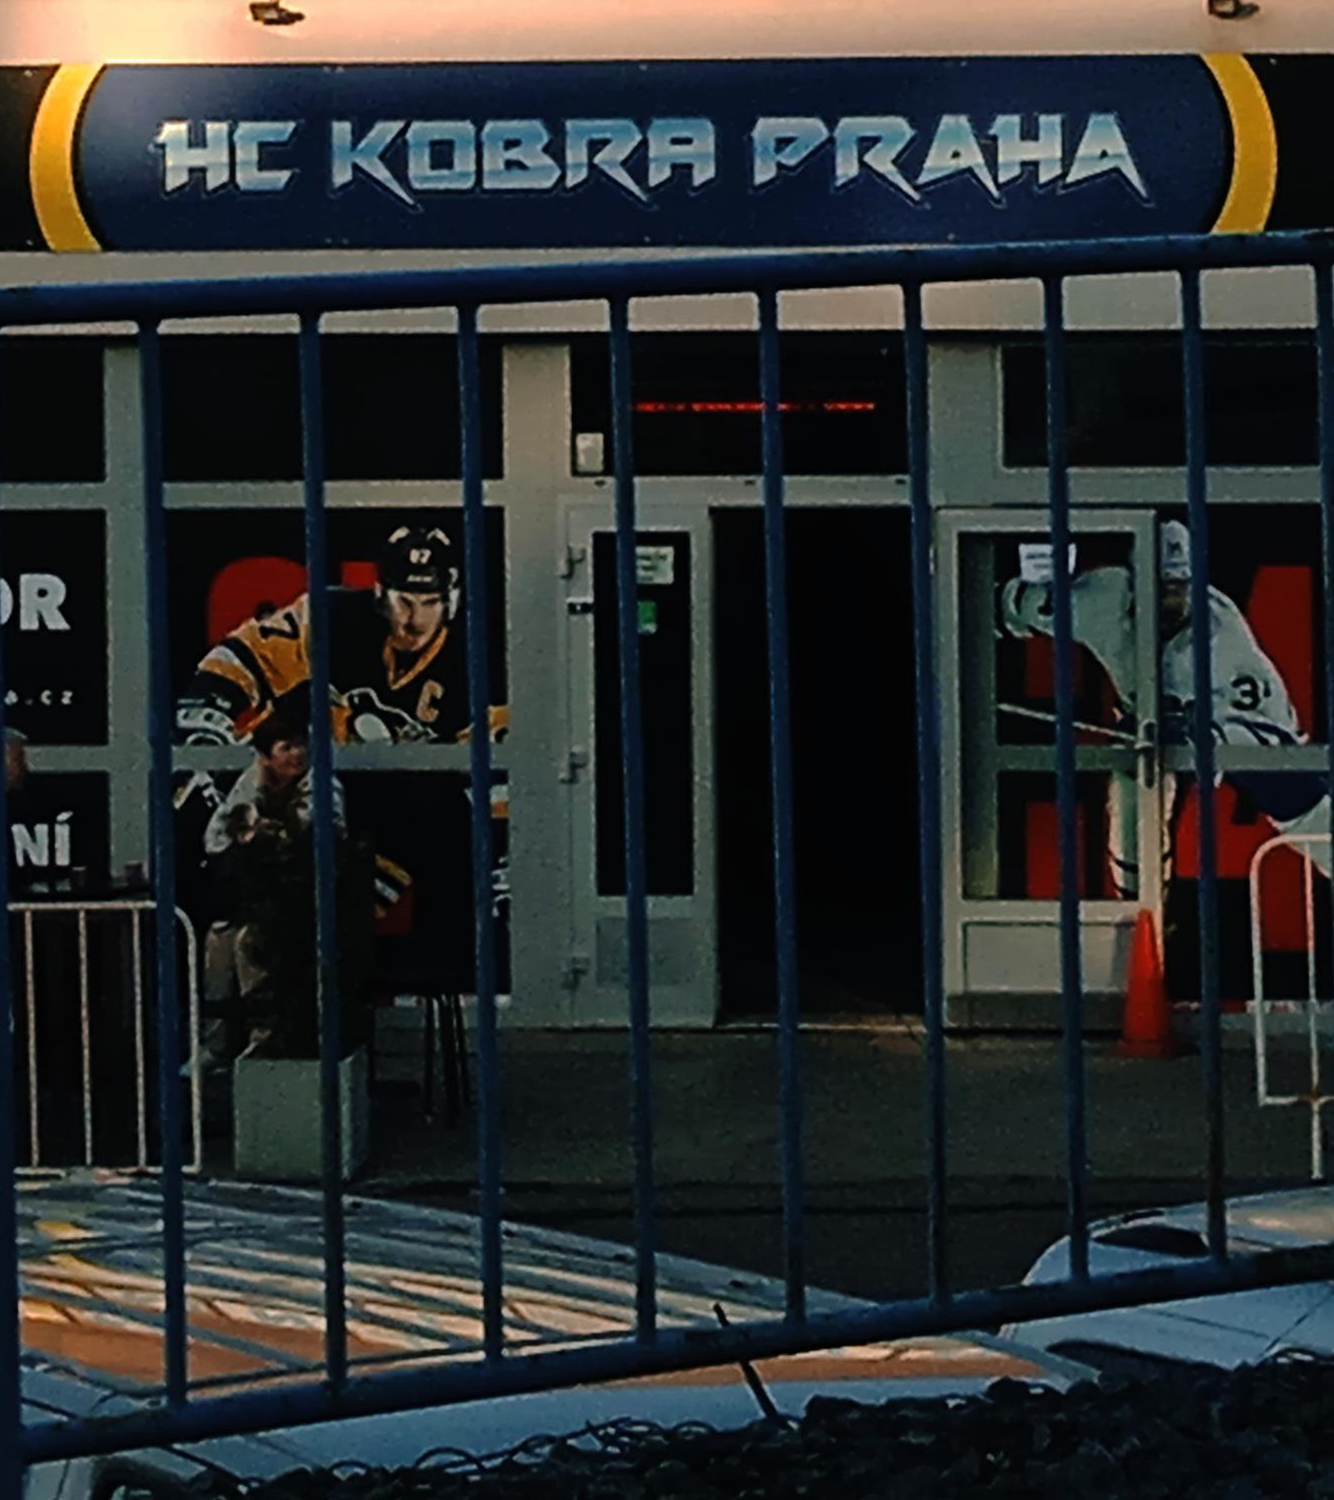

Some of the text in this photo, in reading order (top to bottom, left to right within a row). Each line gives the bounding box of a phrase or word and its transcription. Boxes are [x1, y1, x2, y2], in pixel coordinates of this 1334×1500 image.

[155, 112, 1153, 209] HC KOBRA PRAHA
